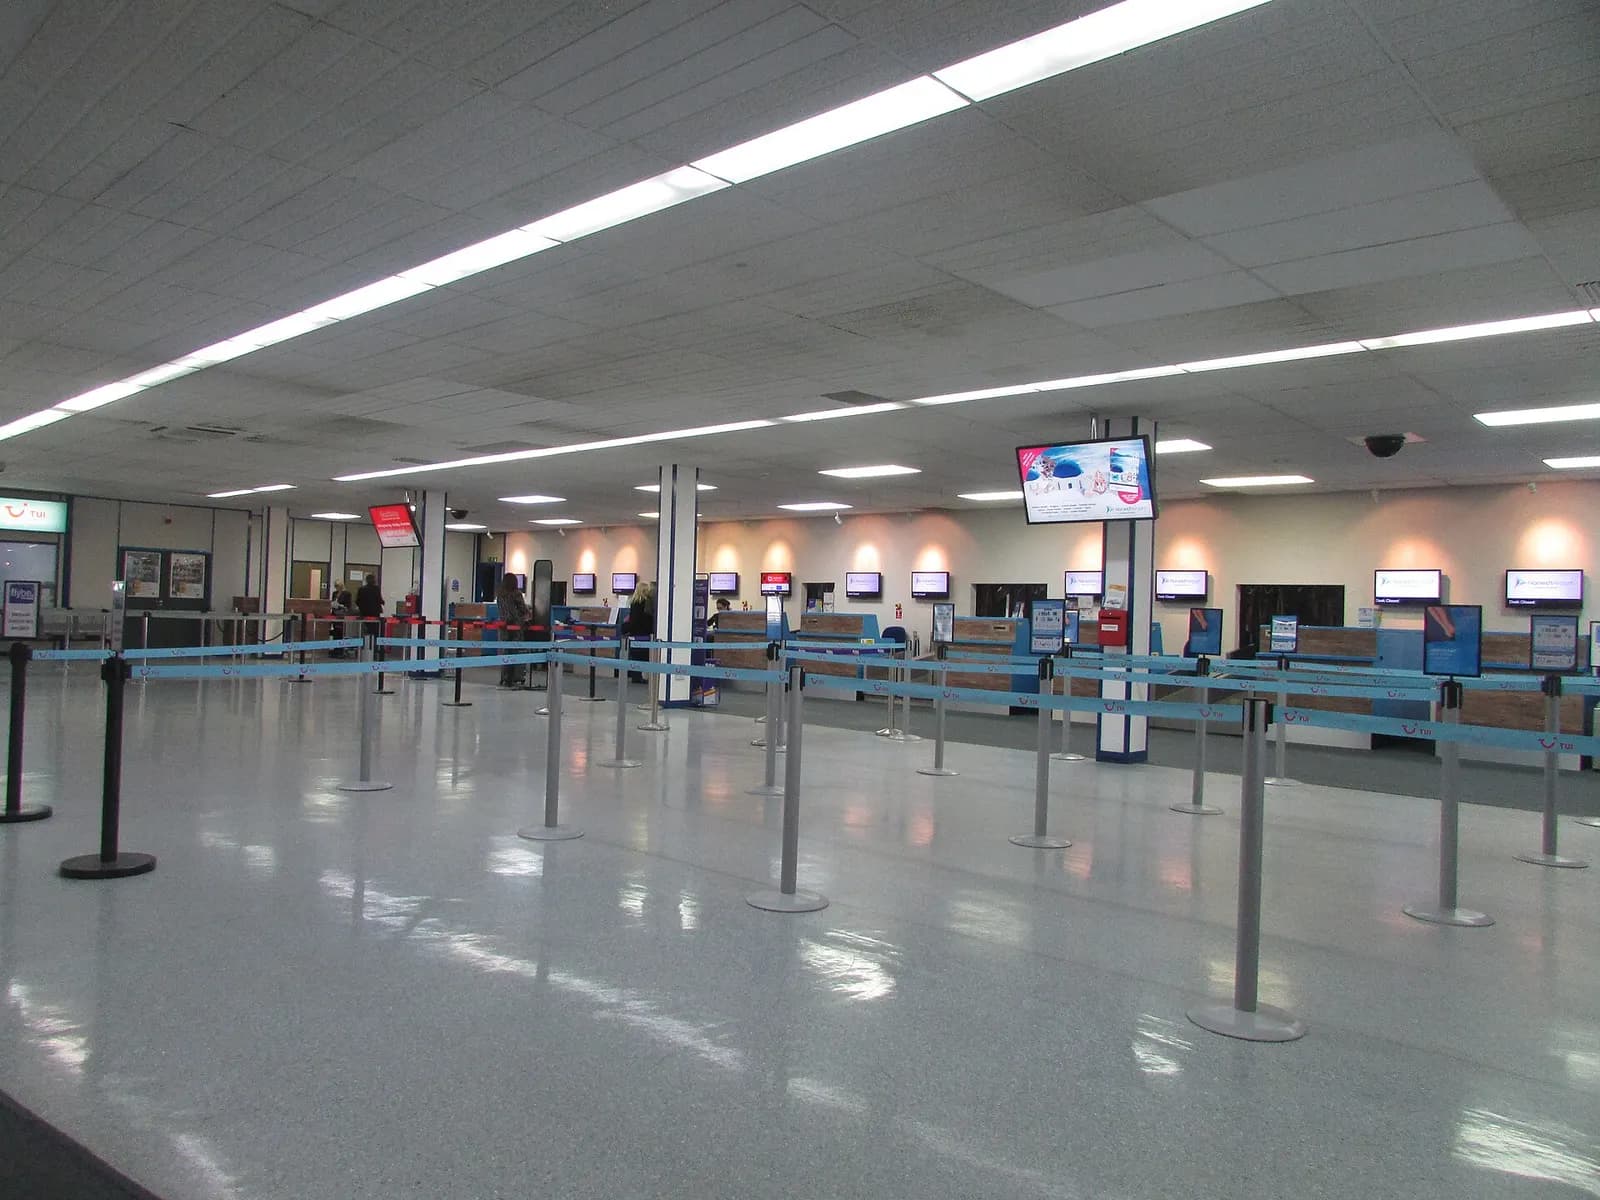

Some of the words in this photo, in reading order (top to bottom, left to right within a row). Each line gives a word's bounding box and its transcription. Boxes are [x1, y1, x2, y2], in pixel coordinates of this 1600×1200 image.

[30, 510, 46, 518] TUI
[1420, 728, 1432, 736] TUI
[1559, 742, 1575, 751] TUI
